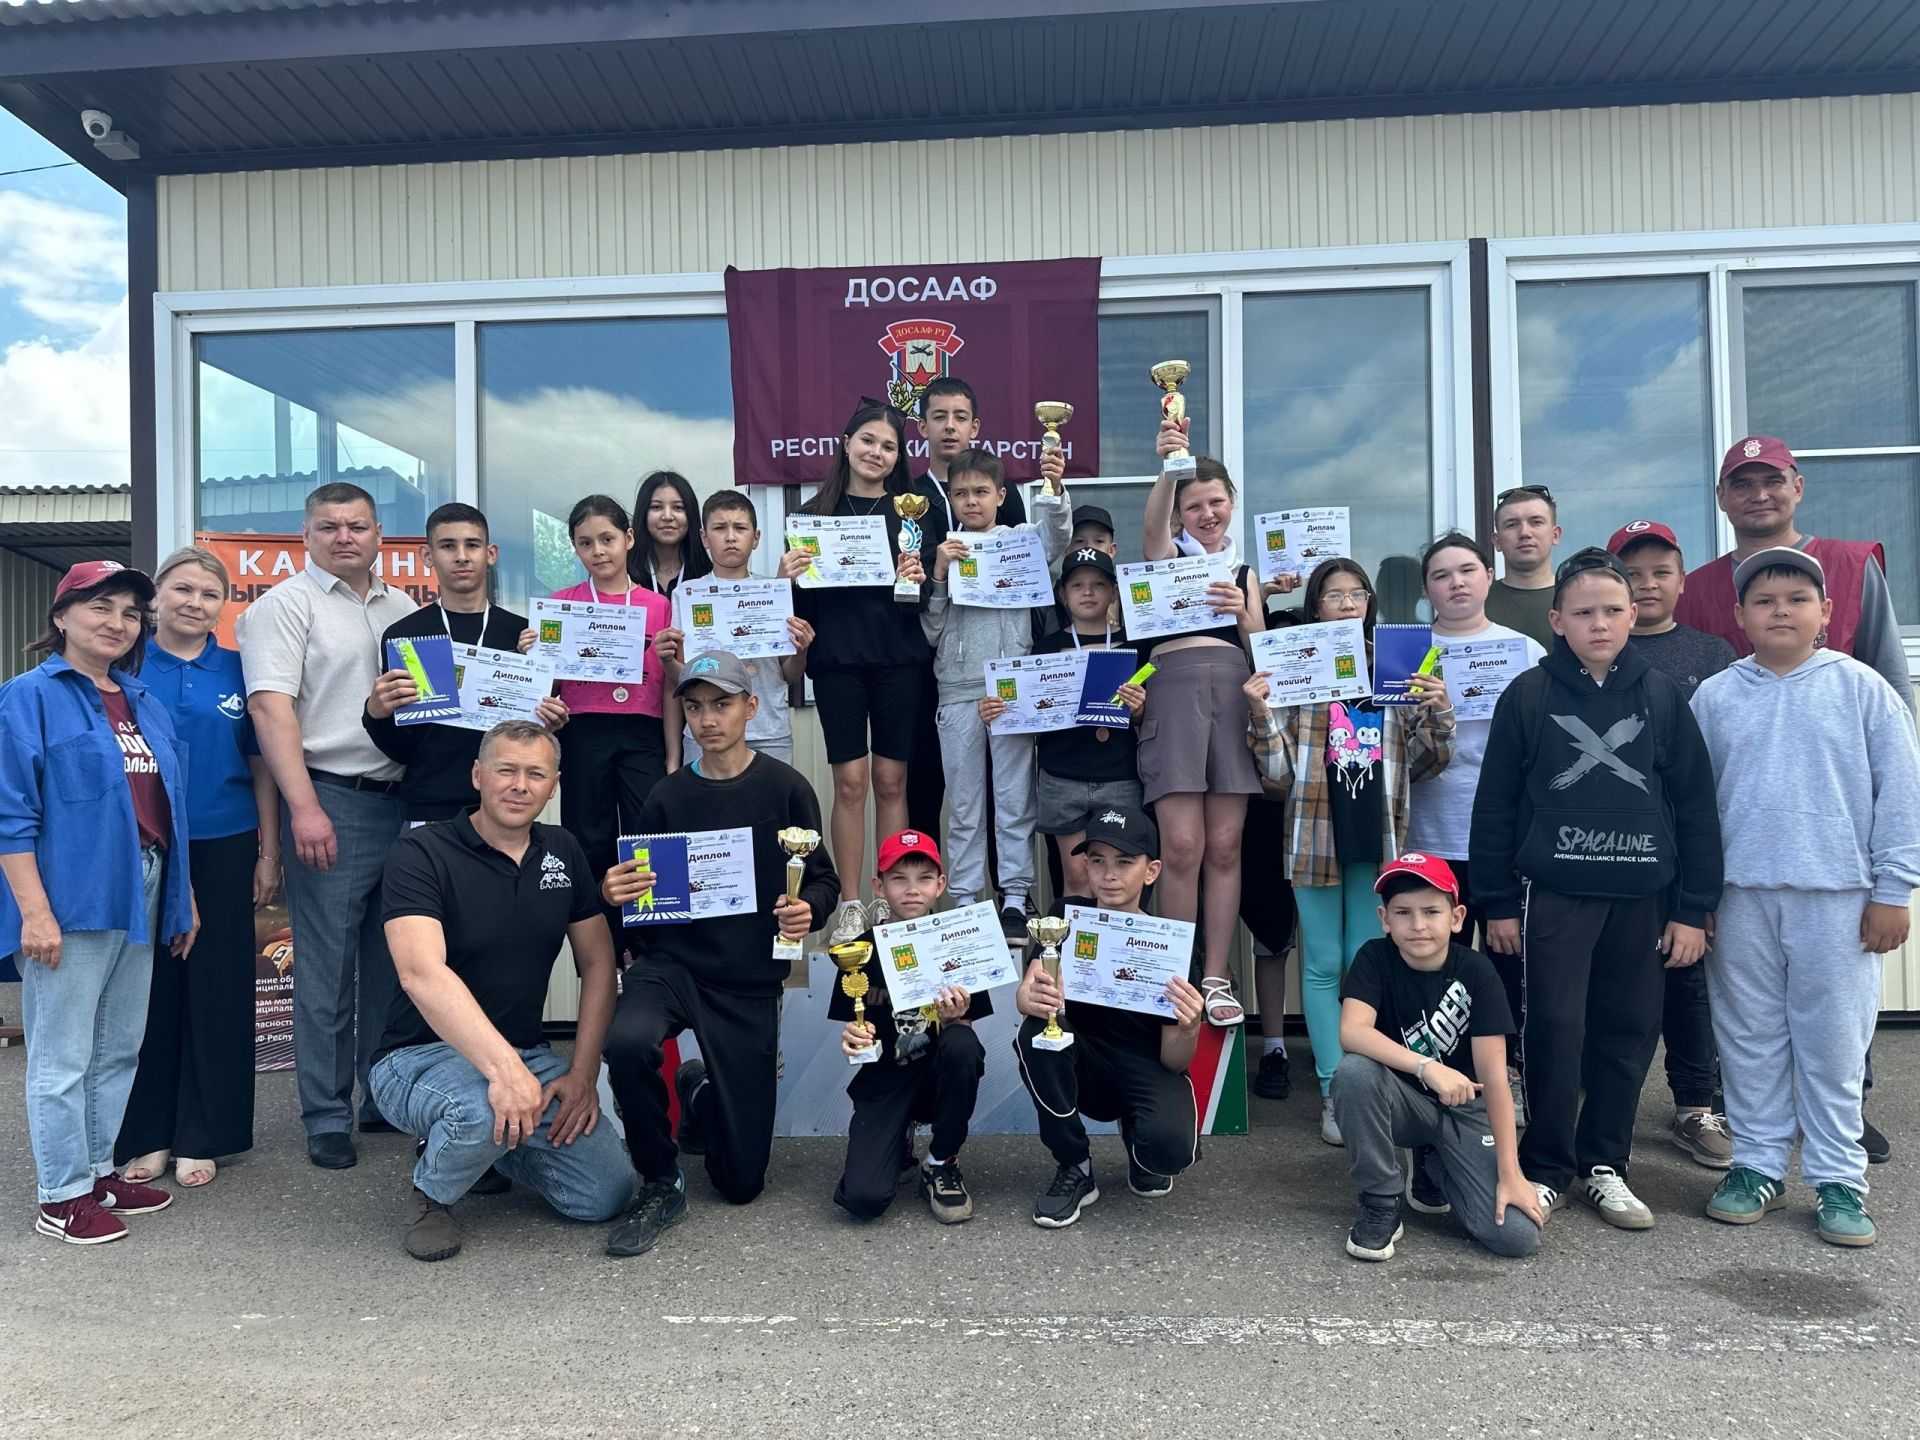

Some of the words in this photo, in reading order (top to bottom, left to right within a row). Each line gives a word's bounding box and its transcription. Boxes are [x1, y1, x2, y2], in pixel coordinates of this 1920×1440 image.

[844, 275, 997, 307] ДОСААФ
[895, 326, 933, 338] ДОСААФ
[935, 328, 947, 337] РТ
[1307, 525, 1335, 533] Диплом
[1000, 552, 1031, 563] Диплом
[1174, 572, 1209, 583] Диплом
[738, 600, 774, 609] Диплом
[588, 621, 626, 631] Диплом
[1469, 659, 1507, 669] Диплом
[493, 670, 532, 684] Диплом
[1040, 671, 1075, 682] Диплом
[1277, 676, 1312, 687] Диплом
[1556, 825, 1658, 853] SPACALINE
[689, 851, 730, 863] Диплом
[1554, 853, 1584, 861] AVENGING
[1585, 854, 1615, 862] ALLIANCE
[539, 872, 571, 884] АРЧА
[539, 881, 572, 890] БАЛАСЫ
[941, 926, 979, 942] Диплом
[1126, 937, 1168, 950] Диплом
[256, 977, 278, 985] ение
